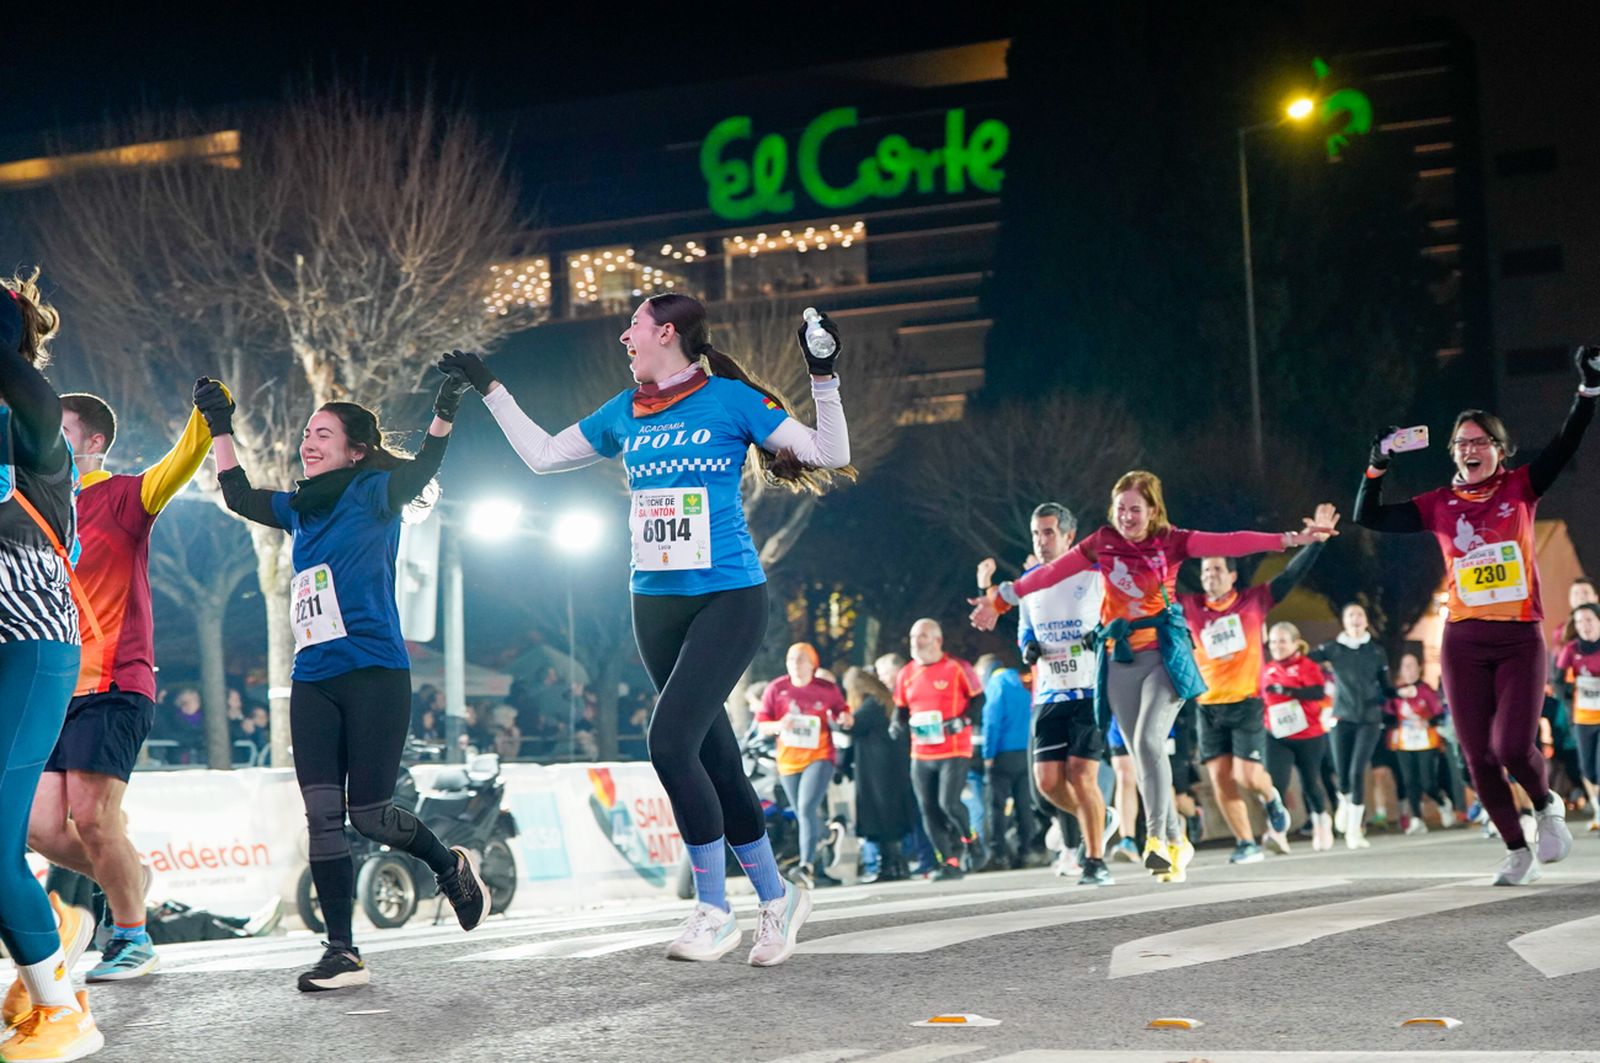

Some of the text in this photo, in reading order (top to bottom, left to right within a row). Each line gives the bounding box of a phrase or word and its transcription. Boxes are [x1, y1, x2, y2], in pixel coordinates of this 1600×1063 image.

[700, 106, 1010, 221] El Corte
[639, 421, 685, 434] ACADEMIA
[643, 518, 691, 543] 6014
[1474, 564, 1506, 585] 230
[1049, 659, 1077, 675] 1059
